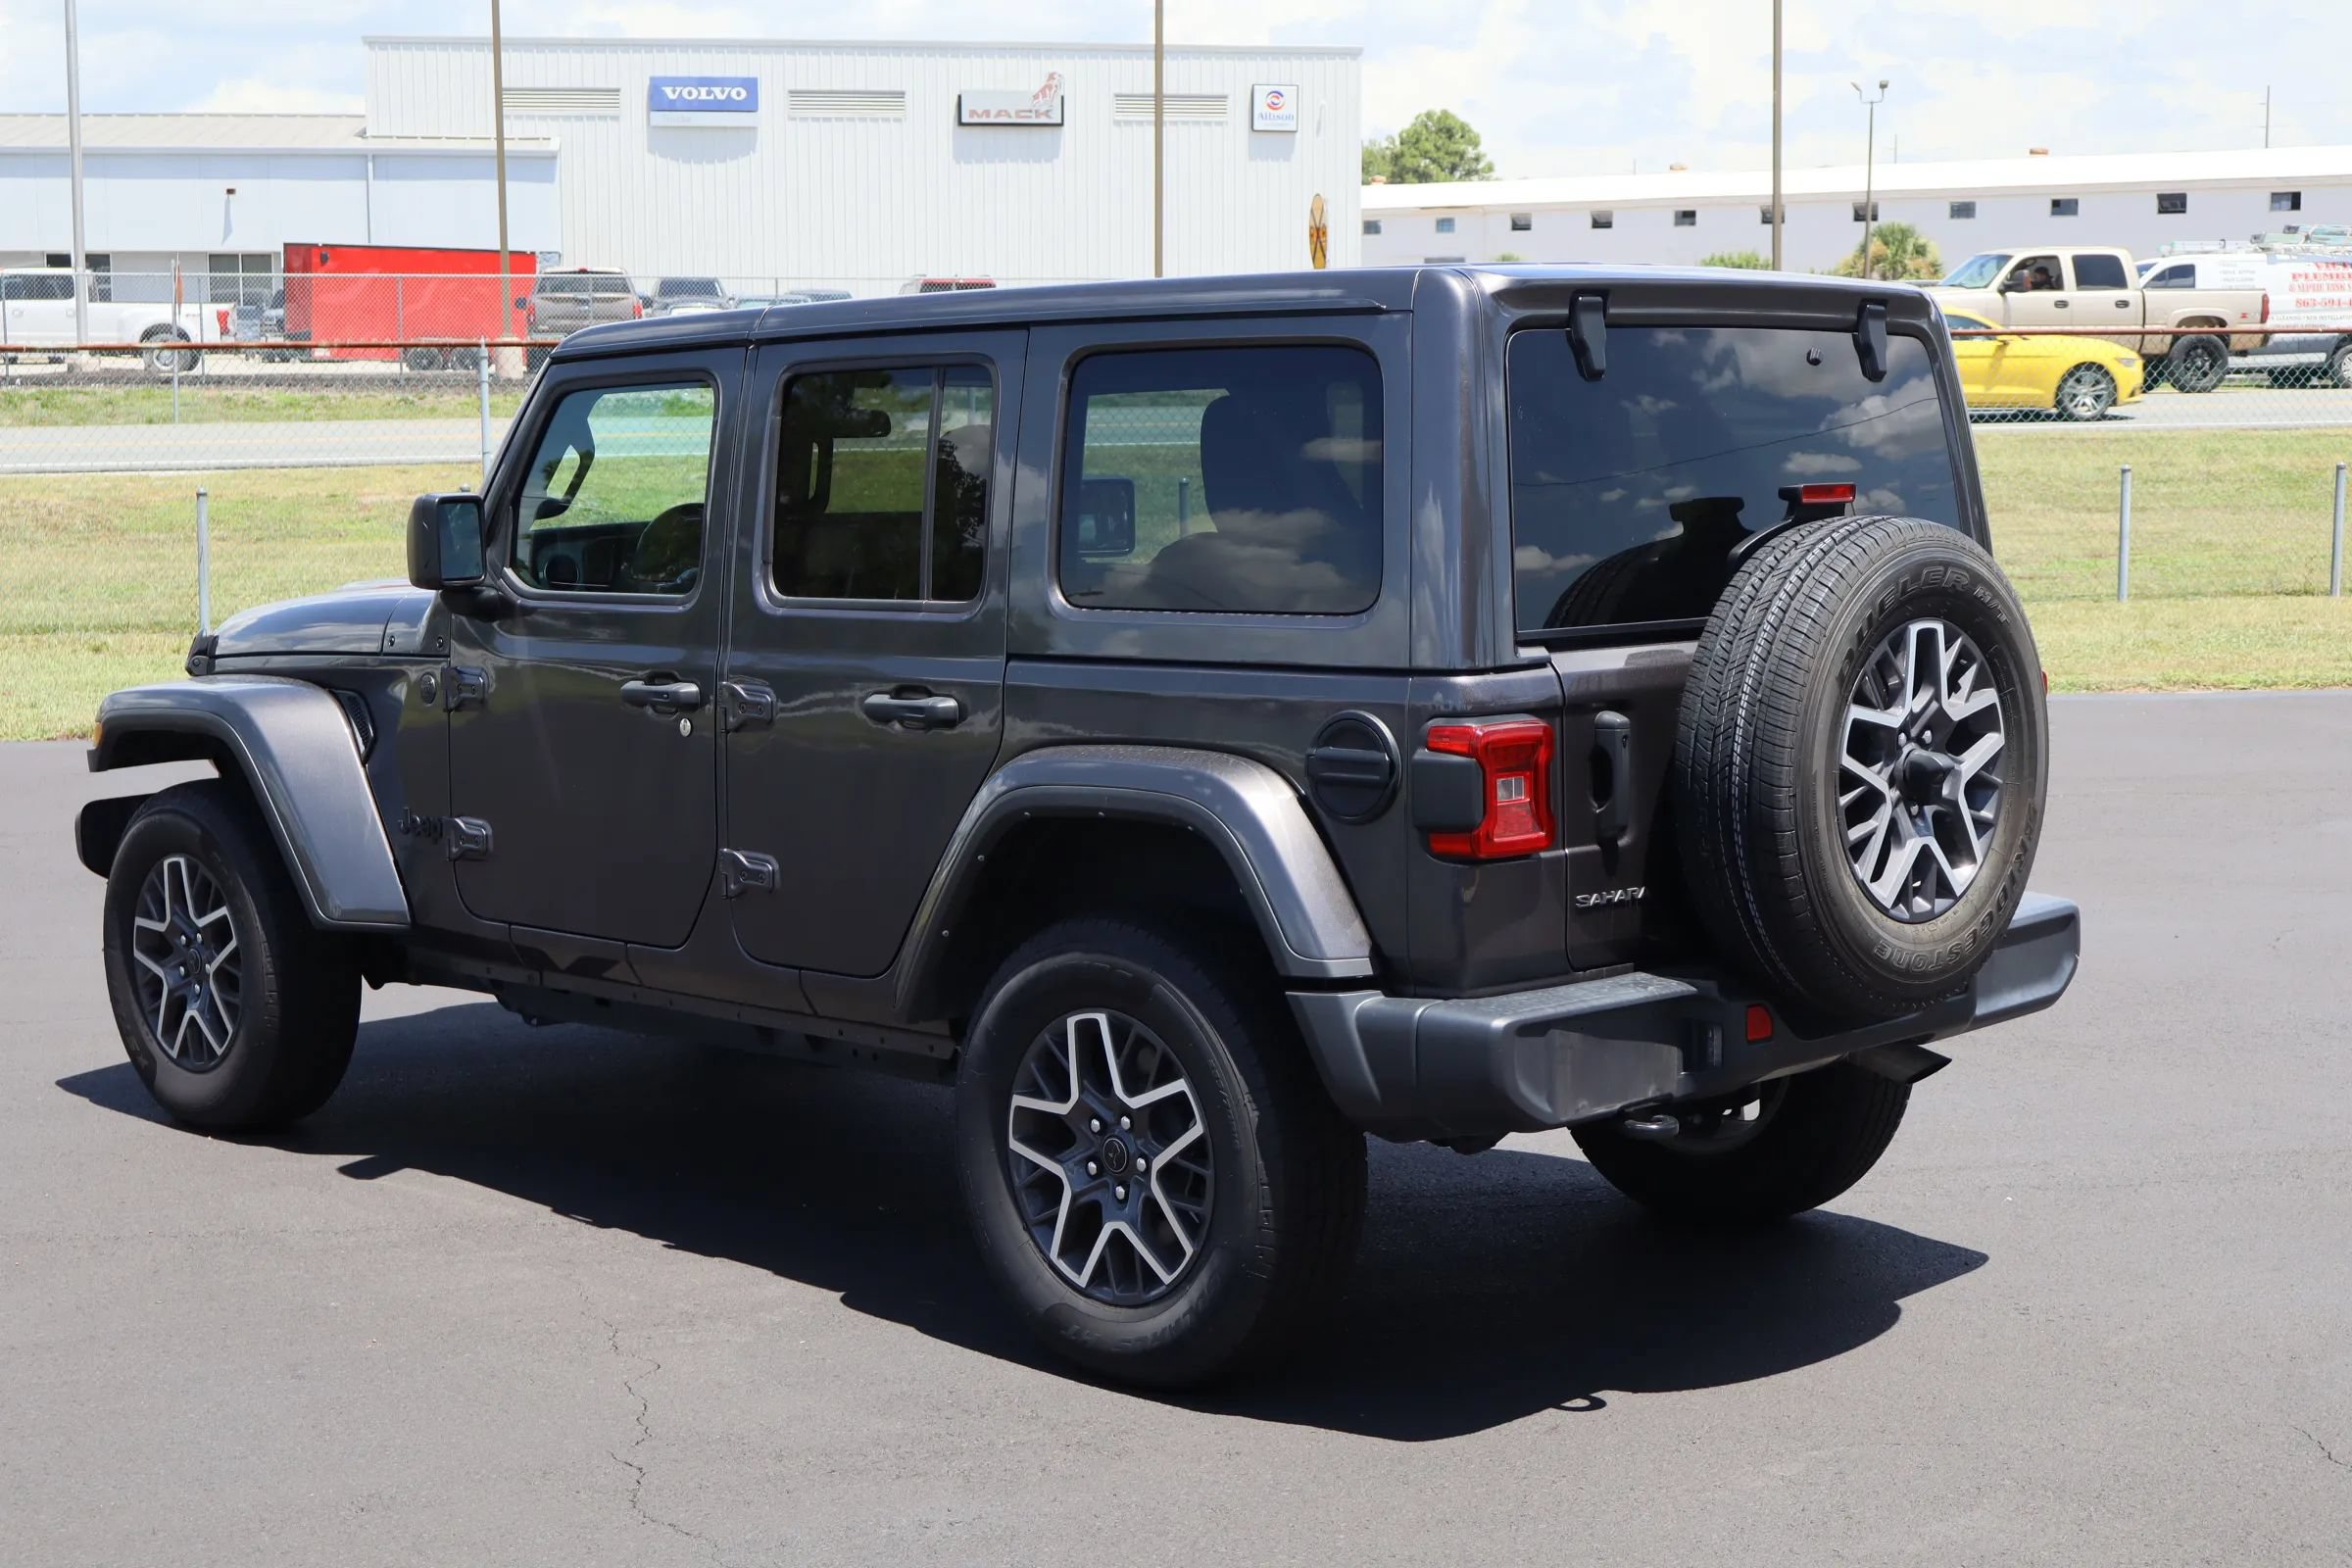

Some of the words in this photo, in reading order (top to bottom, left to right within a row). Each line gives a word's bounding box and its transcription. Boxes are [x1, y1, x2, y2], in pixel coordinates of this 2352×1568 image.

[662, 86, 747, 101] VOLVO
[968, 109, 1054, 120] MACK
[1258, 112, 1295, 122] Allison
[1836, 564, 1970, 684] DUELER
[1973, 584, 2011, 627] H/T
[397, 806, 444, 846] Jeep
[1873, 802, 2038, 974] BRIDGESTONE
